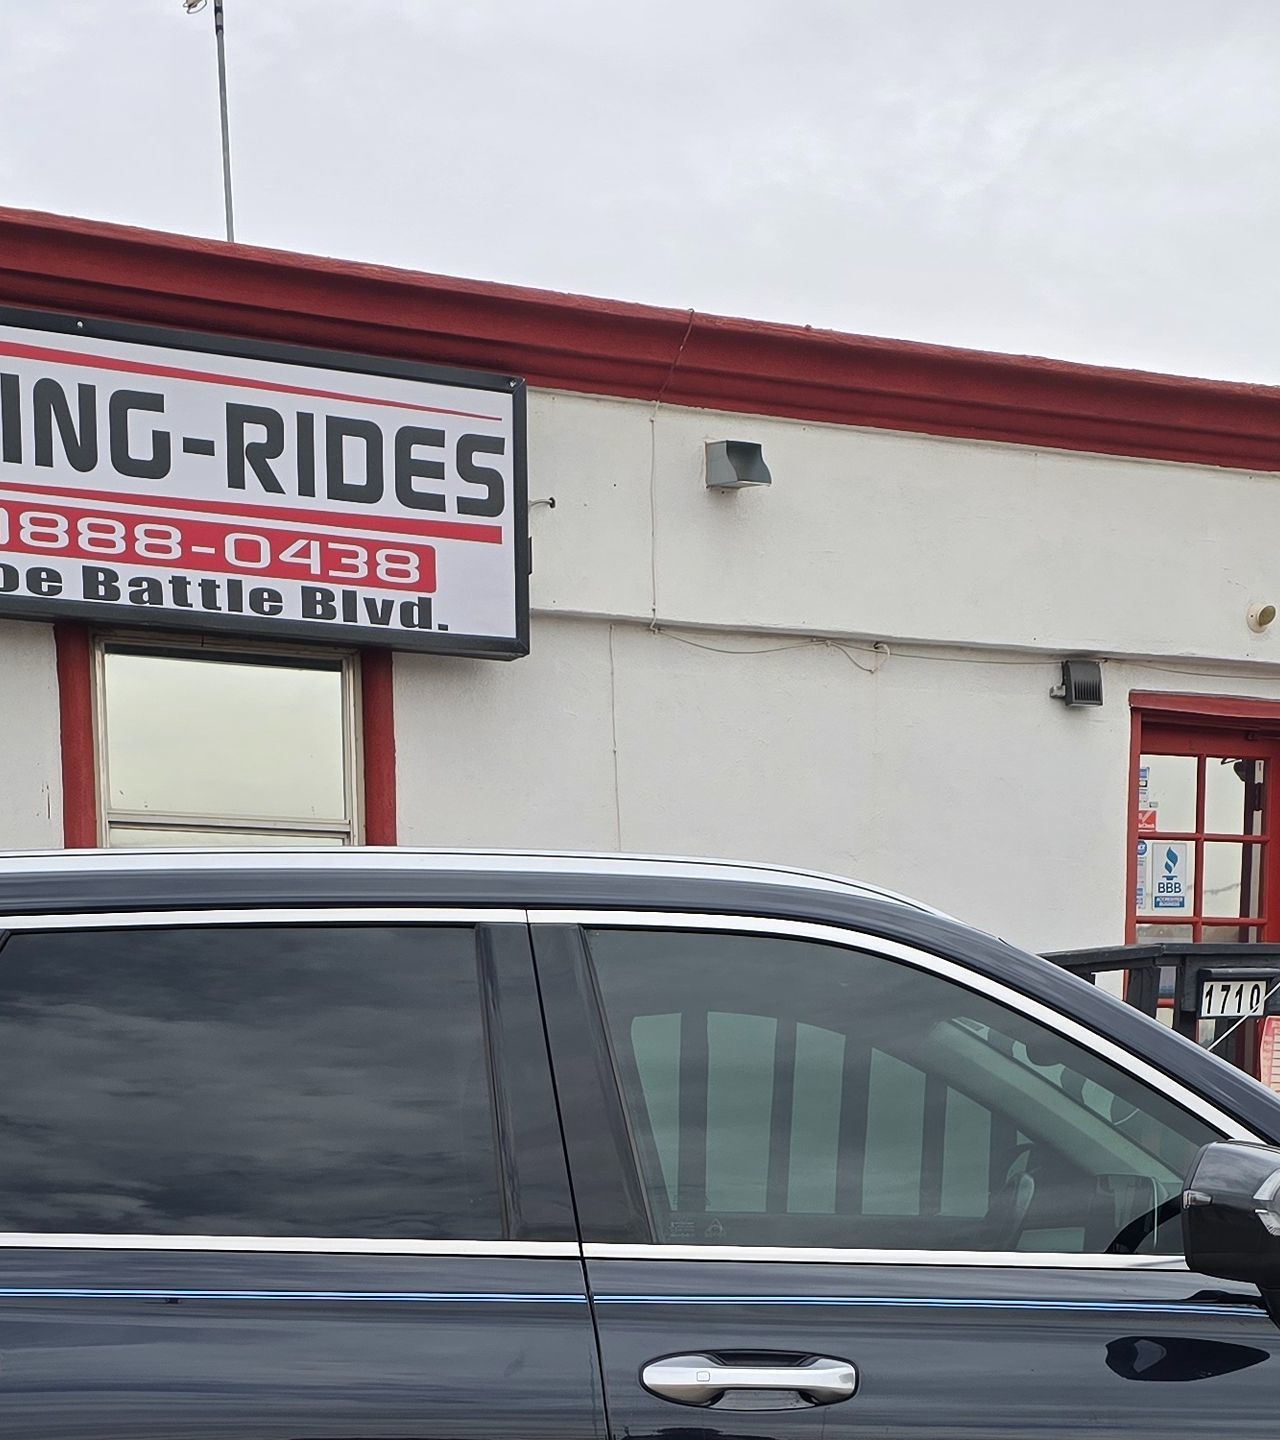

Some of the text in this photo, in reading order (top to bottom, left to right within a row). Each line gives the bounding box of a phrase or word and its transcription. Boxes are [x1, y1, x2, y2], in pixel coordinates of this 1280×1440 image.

[82, 565, 284, 617] Battle
[300, 584, 449, 631] Blvd.
[1158, 882, 1181, 894] BBB
[1205, 984, 1261, 1014] 1710
